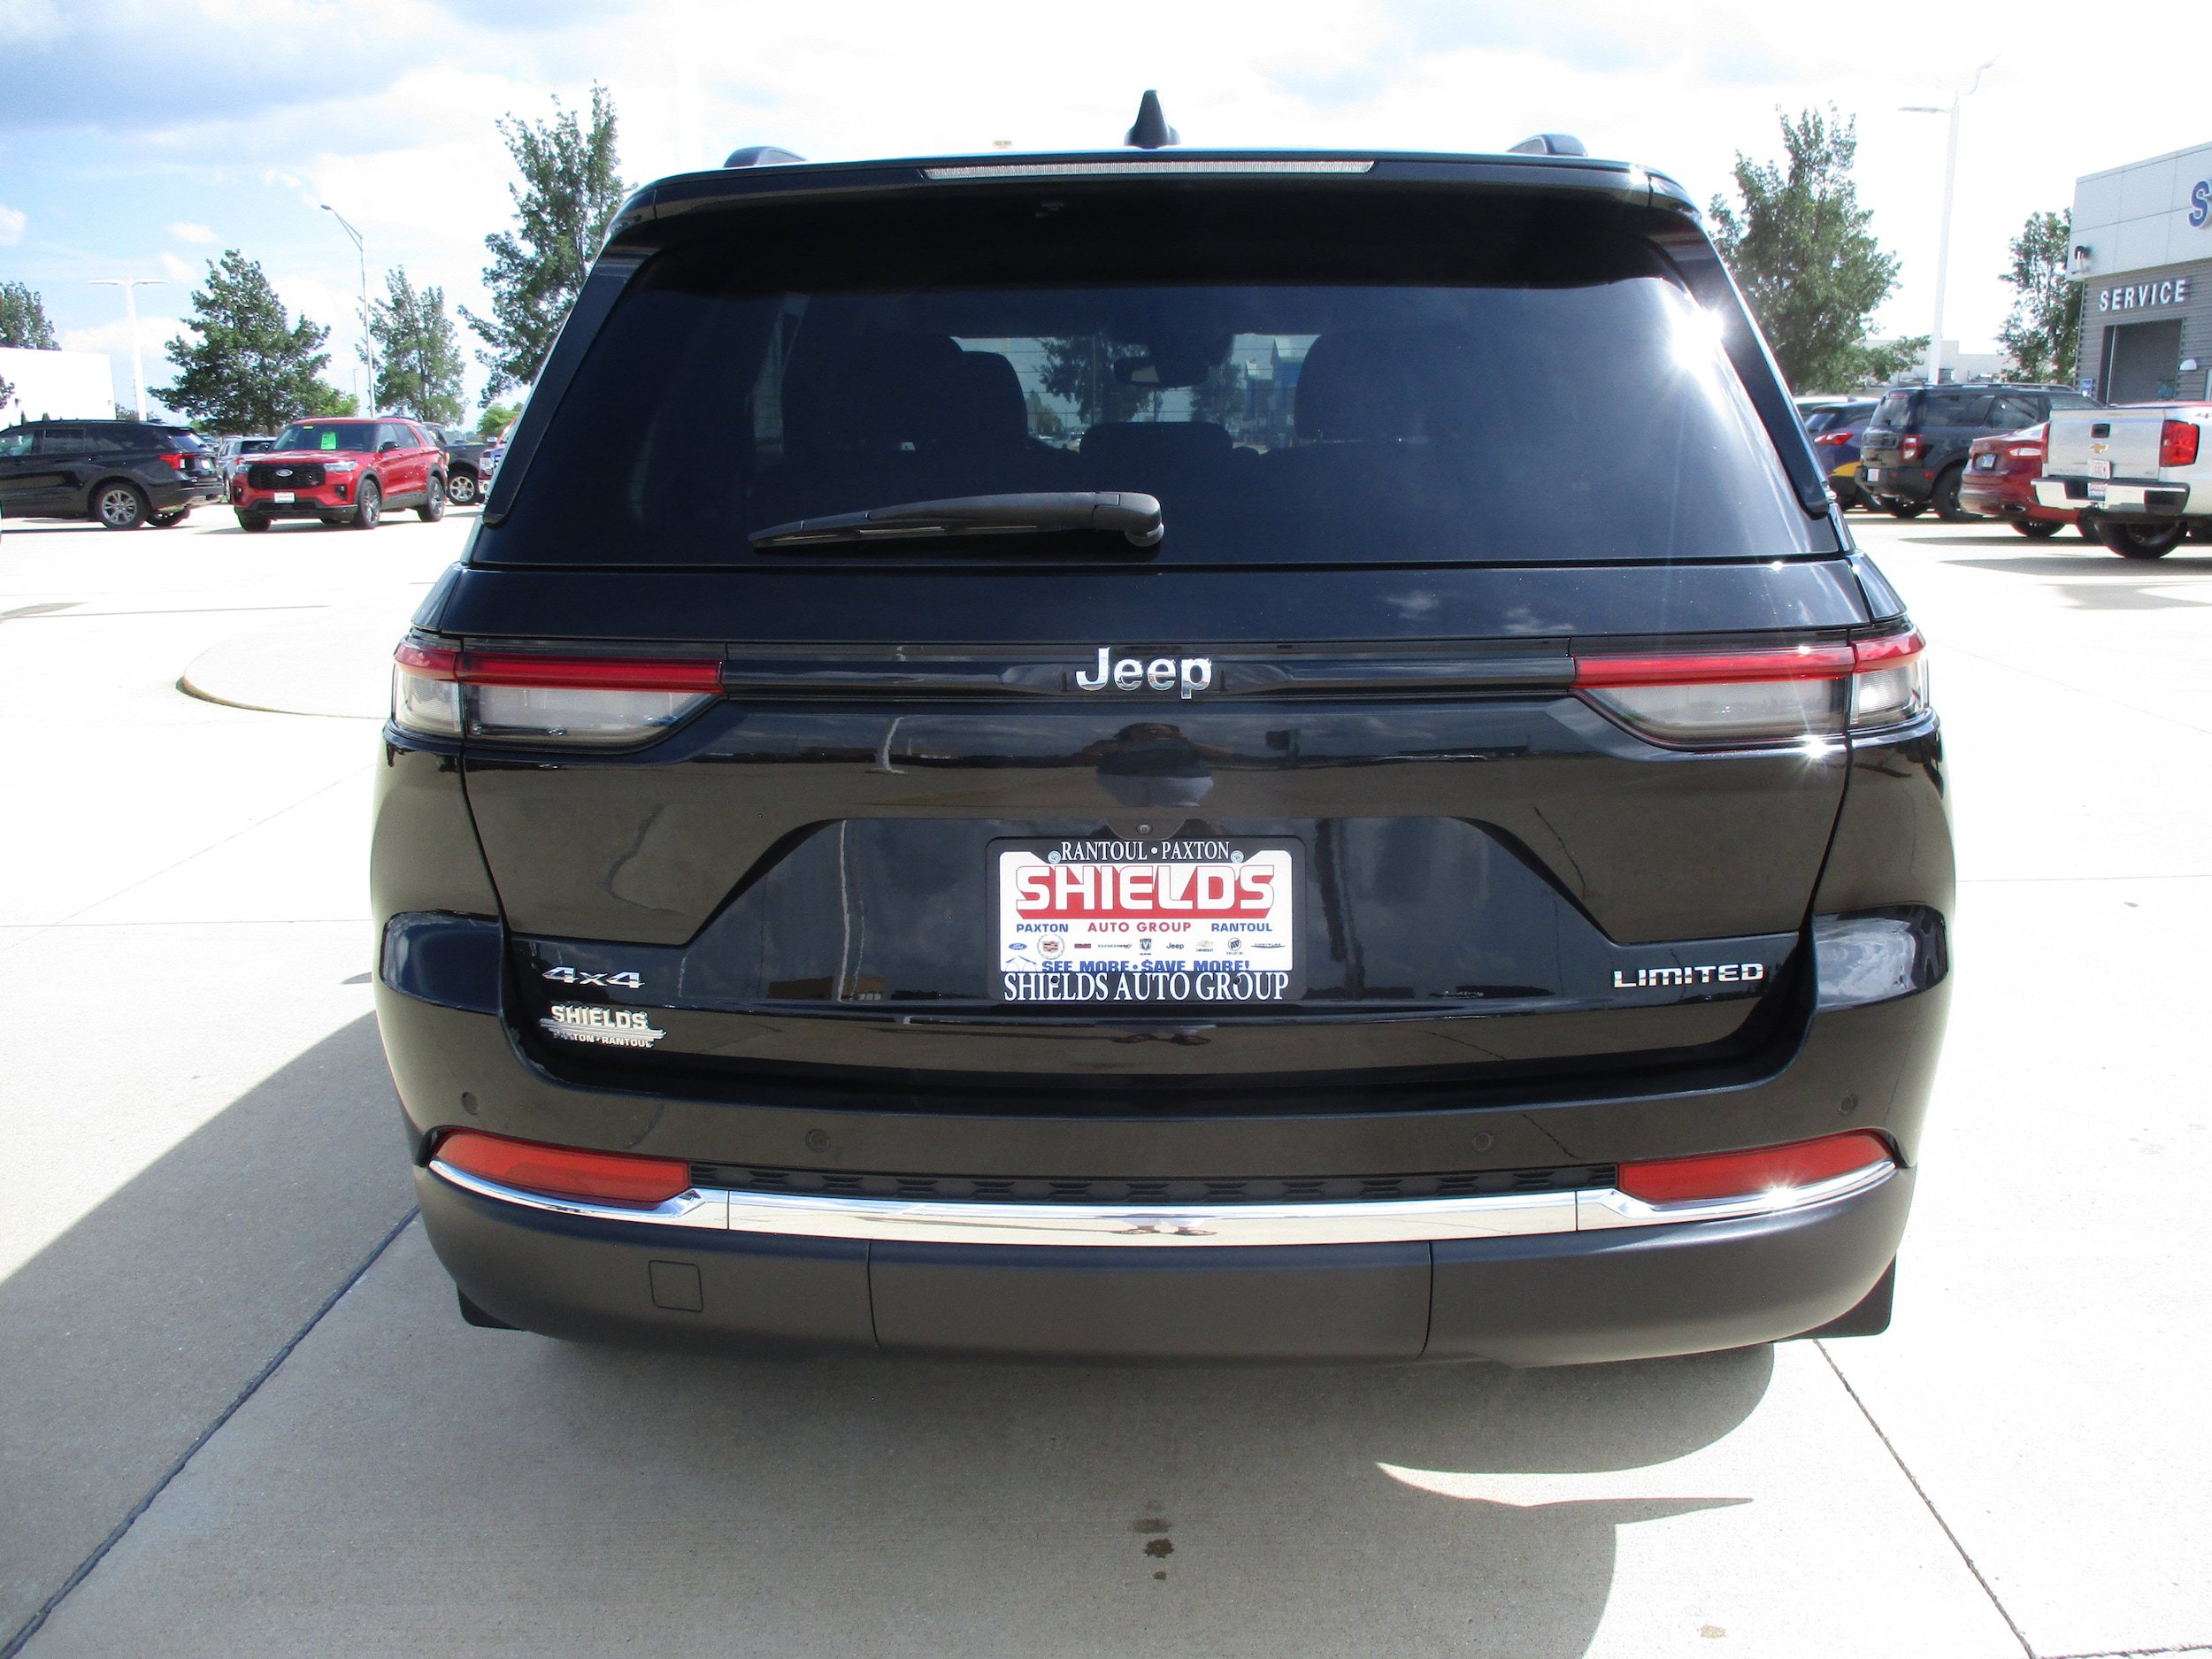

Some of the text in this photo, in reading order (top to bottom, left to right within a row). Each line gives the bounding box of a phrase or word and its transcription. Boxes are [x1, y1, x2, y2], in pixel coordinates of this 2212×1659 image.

[2098, 279, 2188, 312] SERVICE
[1075, 647, 1212, 700] Jeep
[1061, 841, 1230, 861] RANTOUL PAXTON
[1016, 864, 1275, 919] SHIELDS
[1017, 923, 1069, 933] PAXTON
[1087, 922, 1191, 933] AUTO GROUP
[1211, 923, 1272, 932] RANTOUL
[541, 966, 645, 988] 4x4
[1041, 961, 1072, 972] SEE
[1079, 961, 1129, 972] MORE
[1613, 963, 1764, 988] LIMITED
[1003, 972, 1289, 1001] SHIELDS AUTO GROUP
[550, 1004, 649, 1030] SHIELDS
[602, 1036, 655, 1048] RANTOUL
